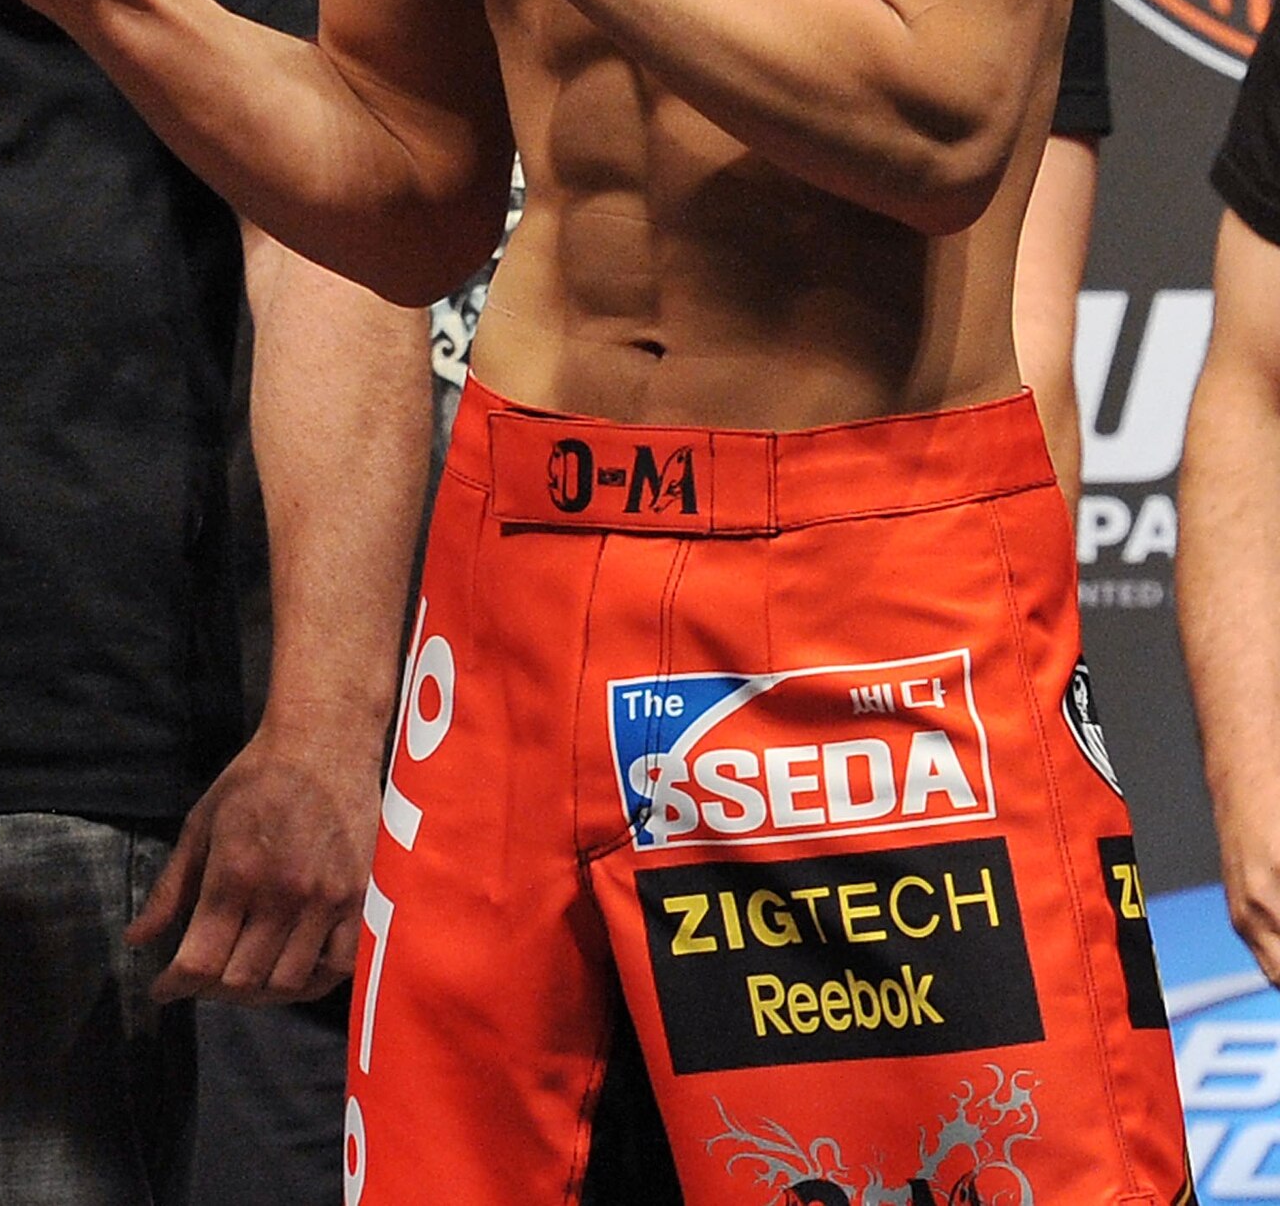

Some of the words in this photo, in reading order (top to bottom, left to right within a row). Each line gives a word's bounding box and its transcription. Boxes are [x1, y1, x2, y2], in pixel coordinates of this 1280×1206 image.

[621, 690, 685, 721] The
[663, 867, 1001, 956] ZIGTECH
[746, 964, 945, 1037] Reebok
